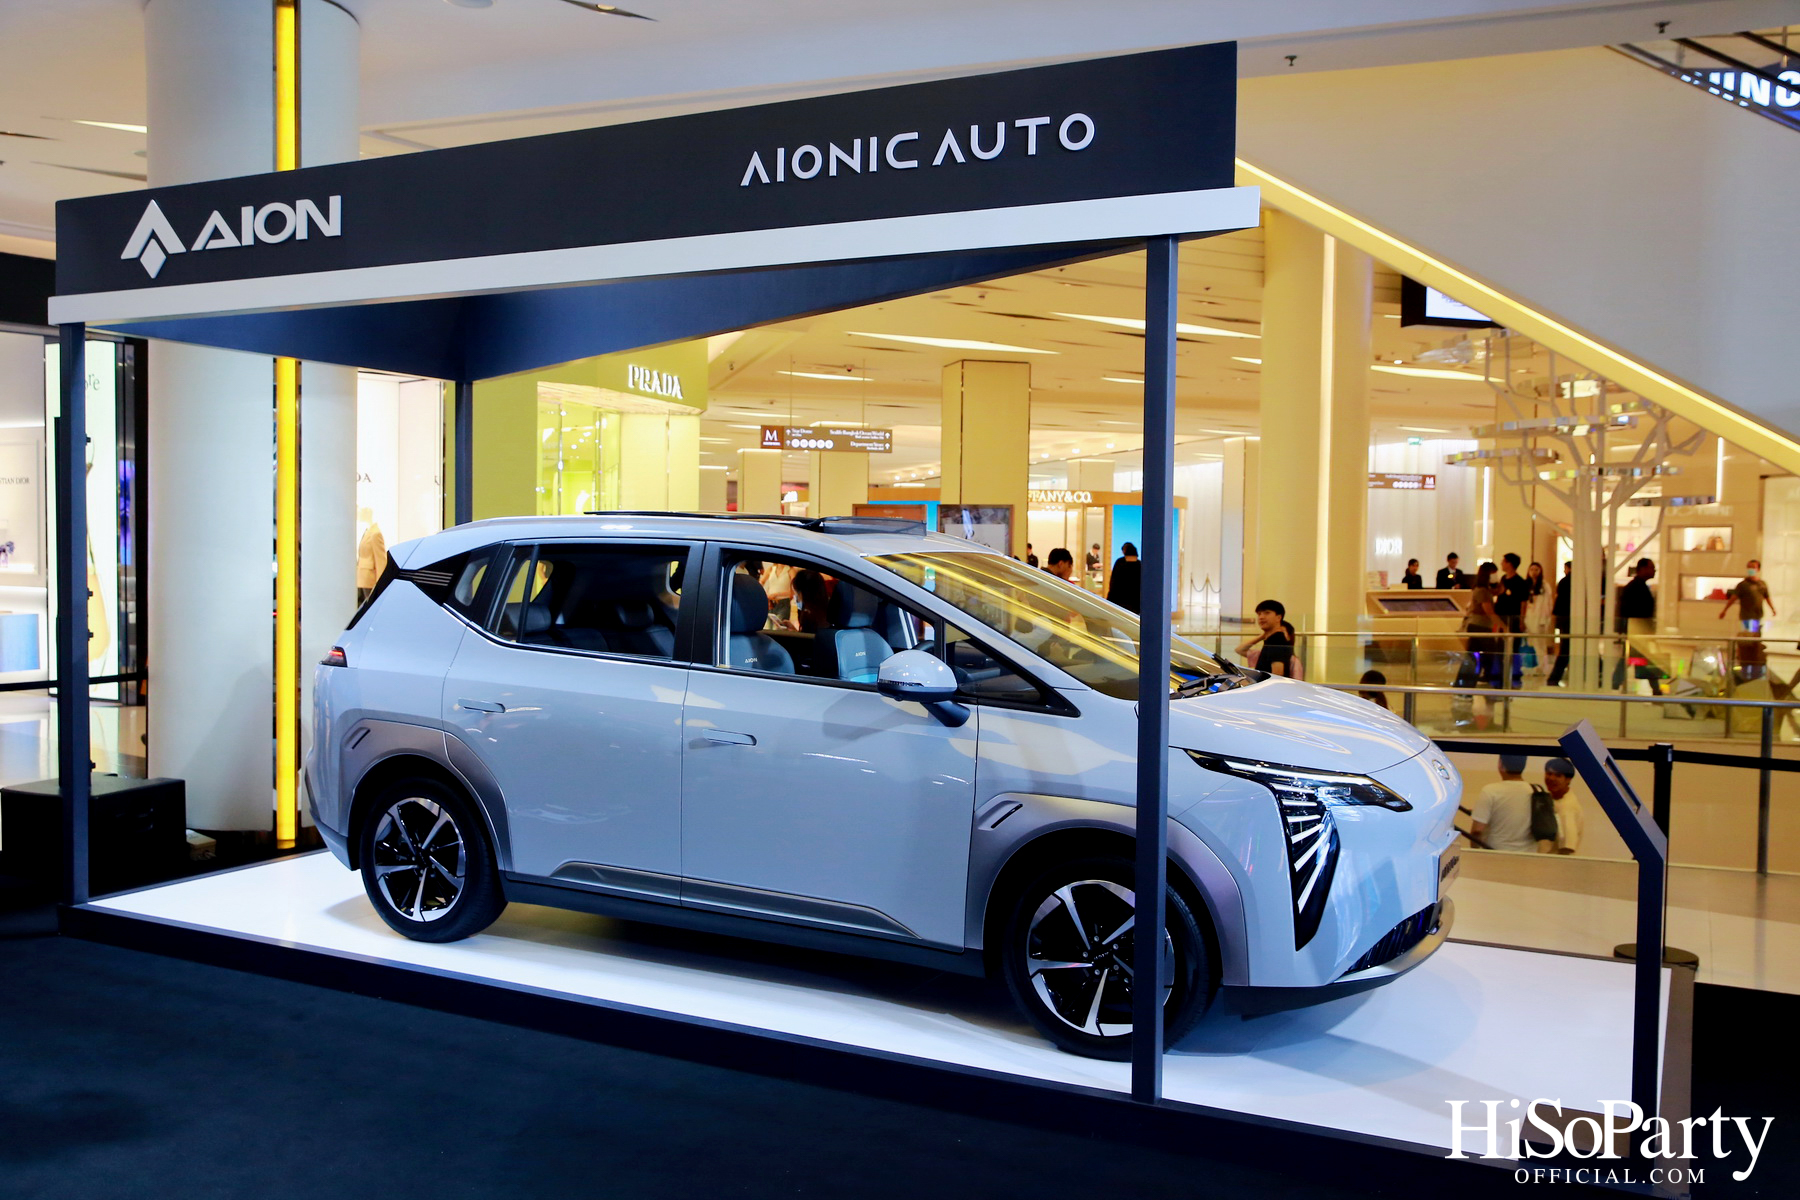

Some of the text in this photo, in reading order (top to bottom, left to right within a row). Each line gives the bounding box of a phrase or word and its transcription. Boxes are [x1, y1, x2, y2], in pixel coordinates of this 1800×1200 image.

[740, 112, 1095, 187] AIONIC AUTO
[190, 195, 342, 252] AION
[628, 364, 683, 400] PRADA
